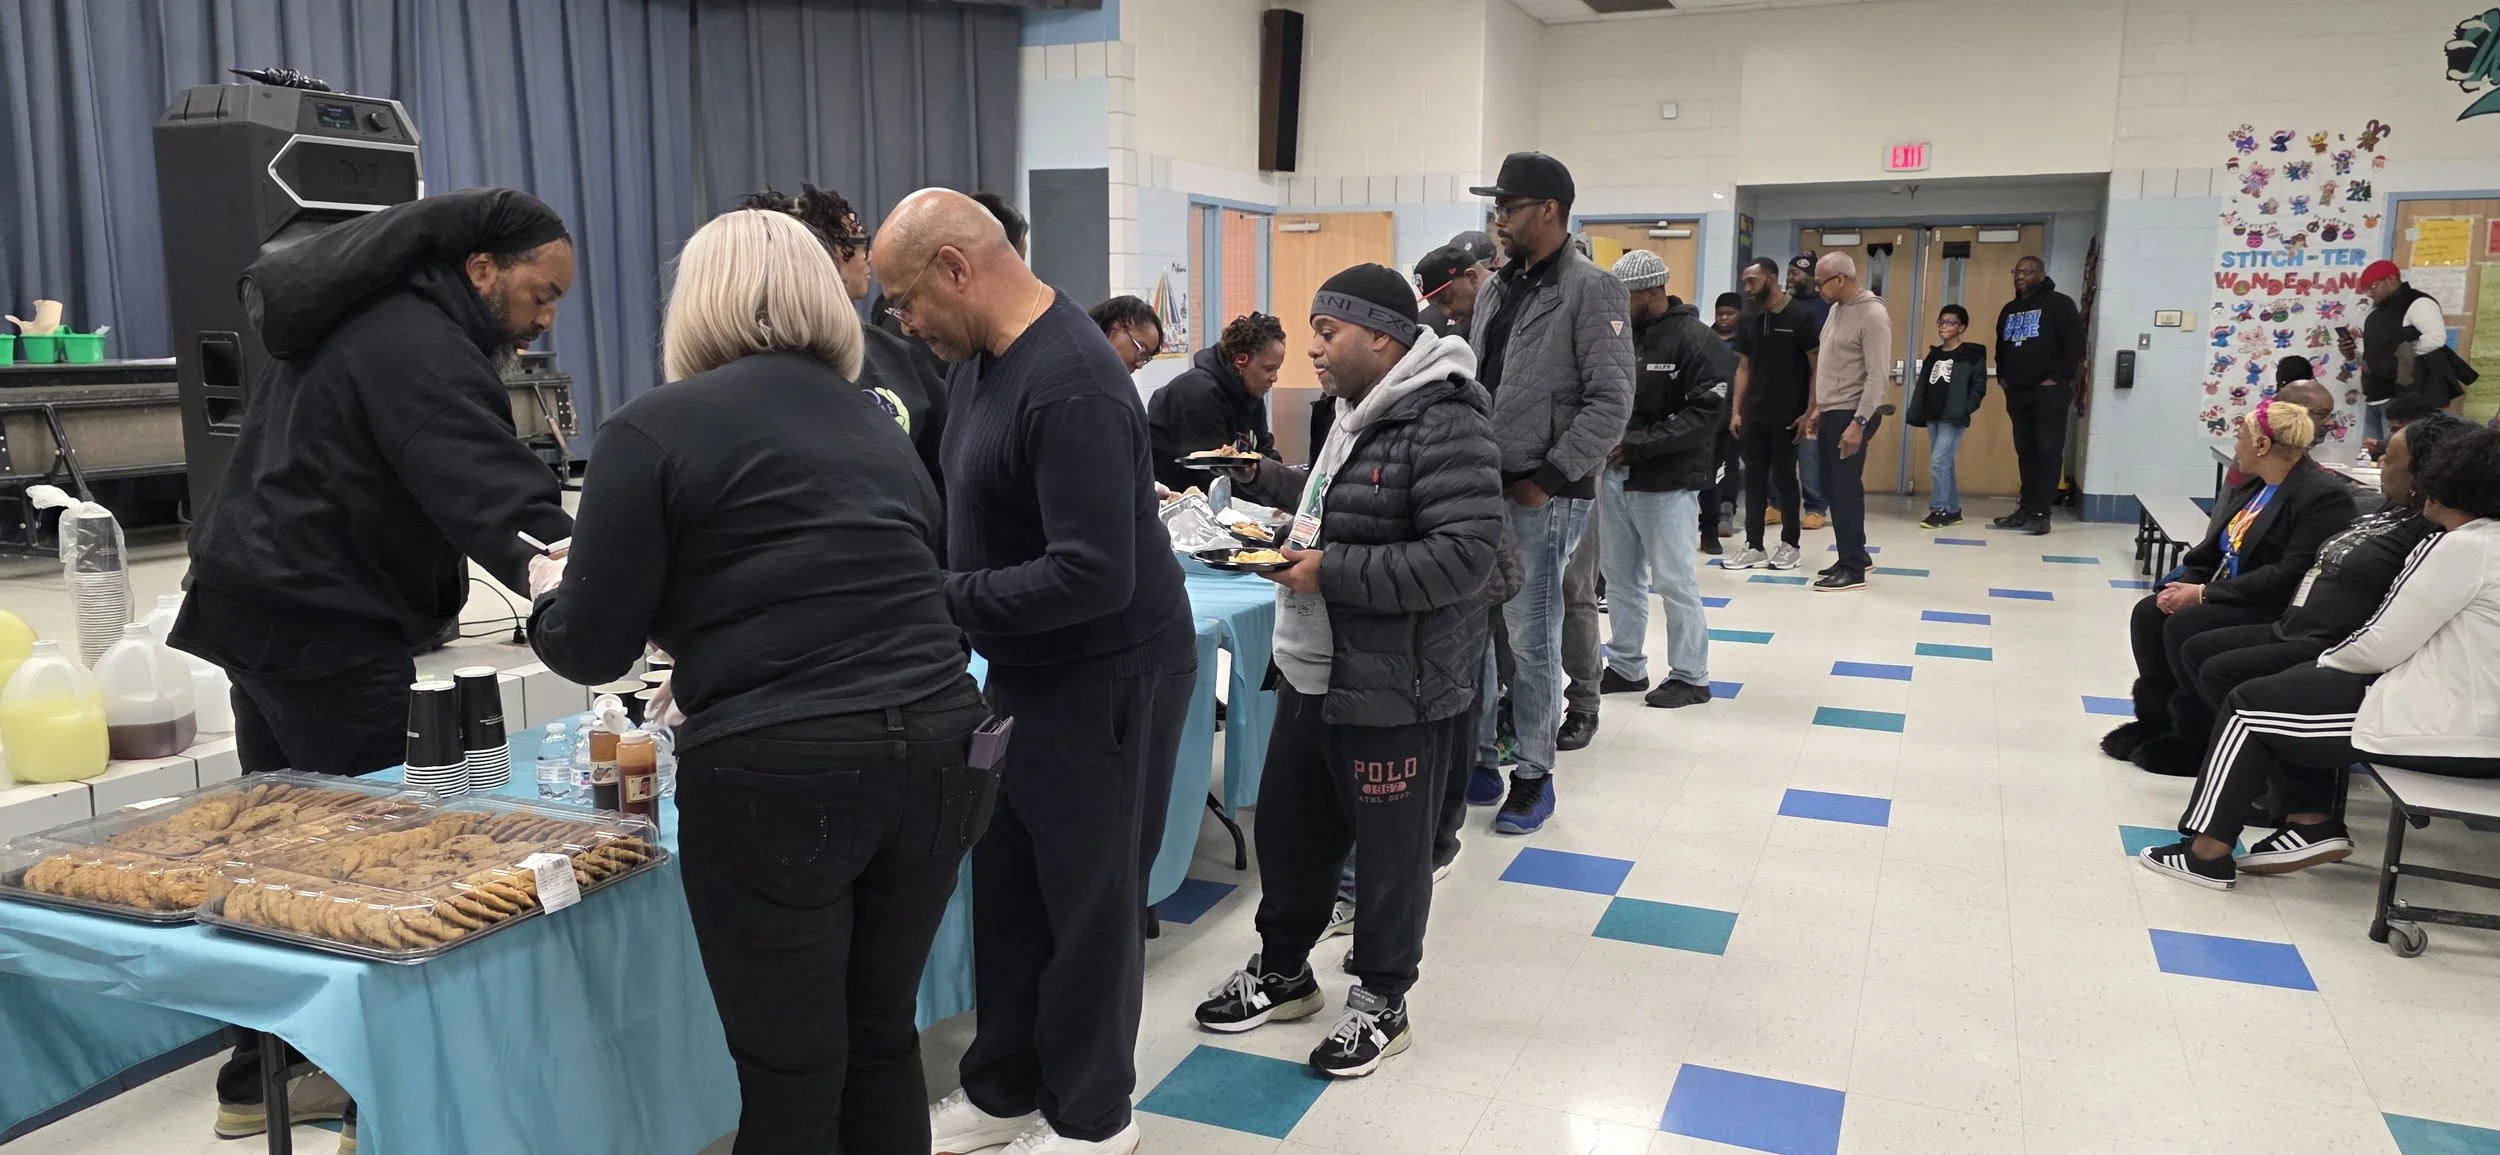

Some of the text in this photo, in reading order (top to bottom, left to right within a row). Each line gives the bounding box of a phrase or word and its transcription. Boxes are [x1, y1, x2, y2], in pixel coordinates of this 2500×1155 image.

[1891, 145, 1923, 168] EXIT
[1353, 757, 1417, 783] POLO
[1370, 783, 1399, 794] 1967
